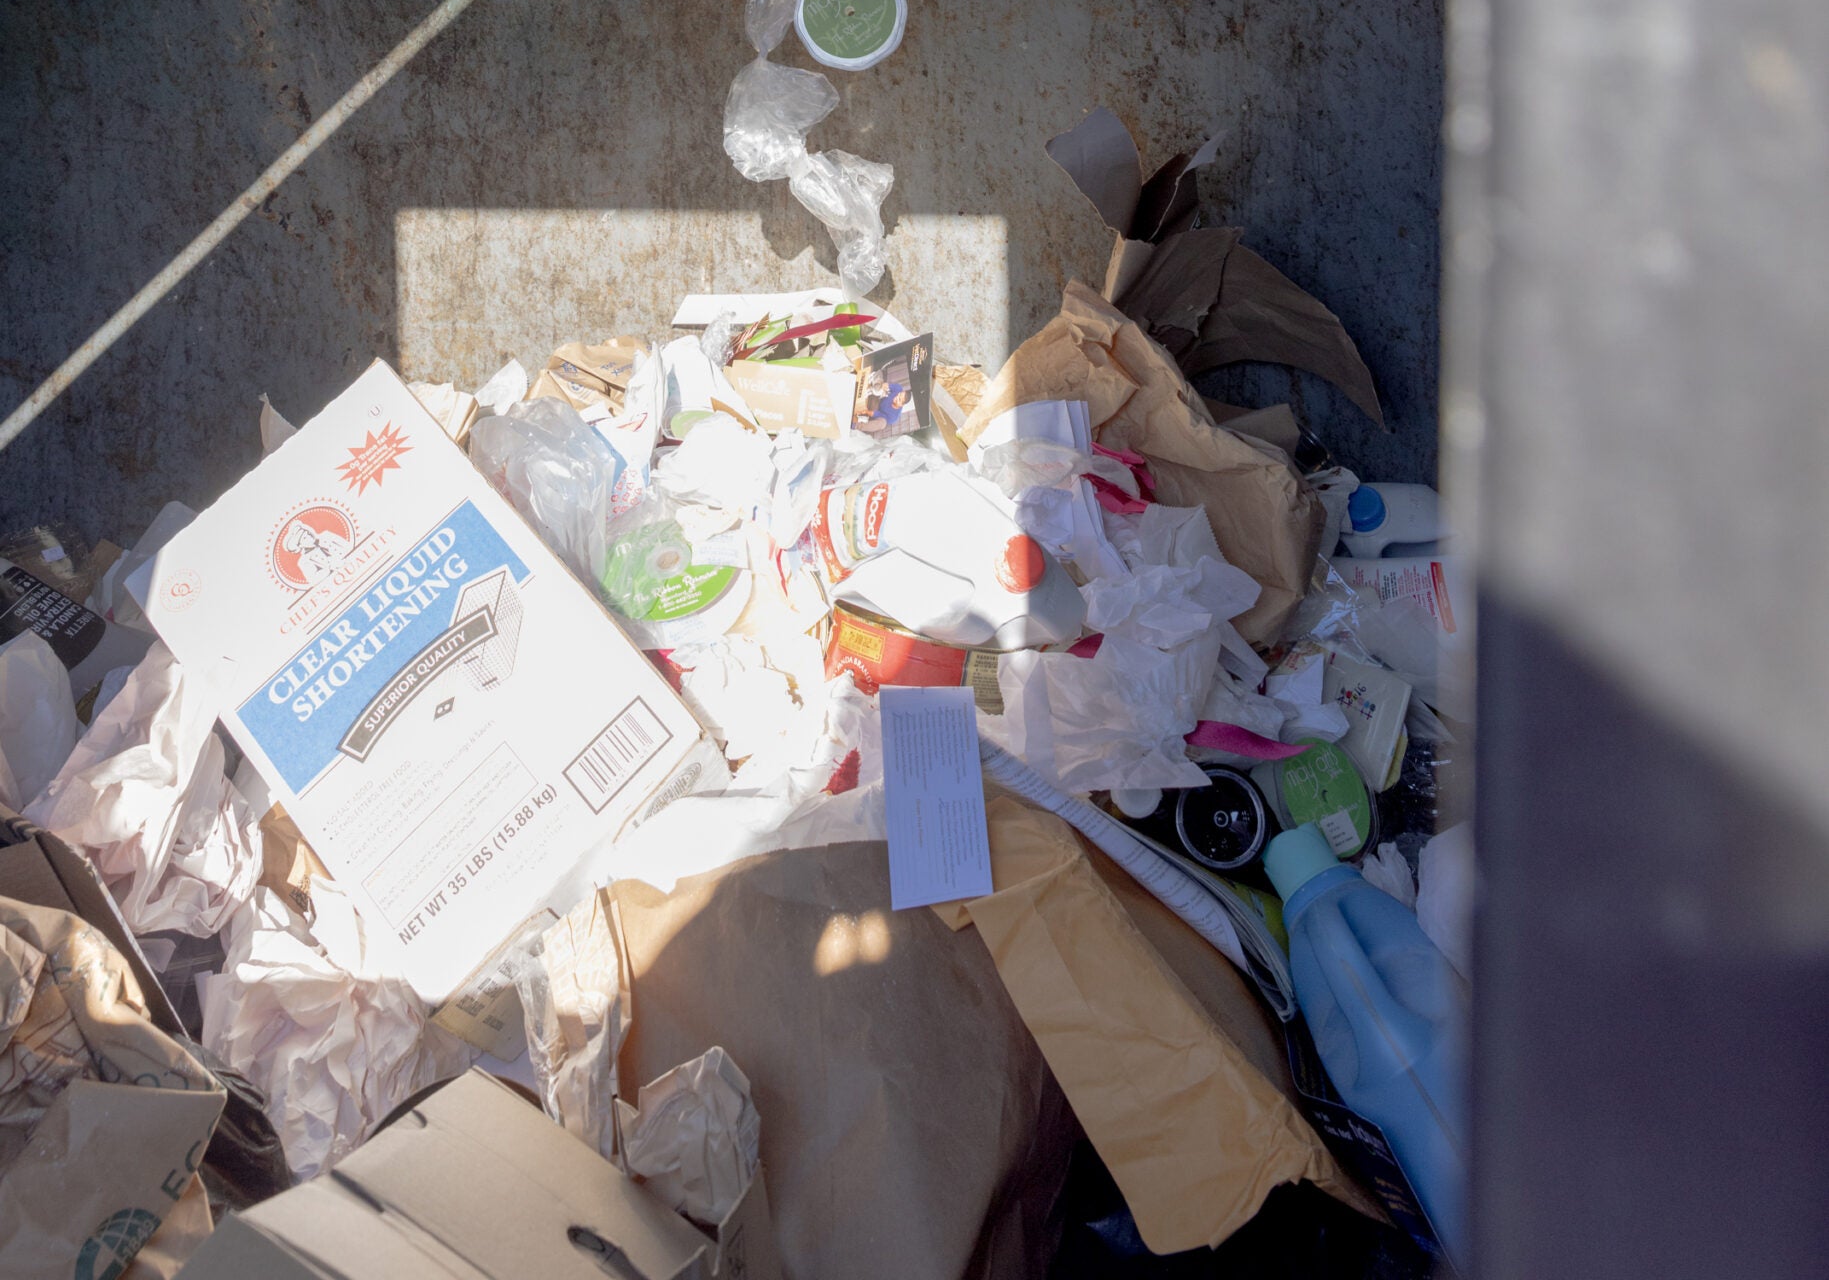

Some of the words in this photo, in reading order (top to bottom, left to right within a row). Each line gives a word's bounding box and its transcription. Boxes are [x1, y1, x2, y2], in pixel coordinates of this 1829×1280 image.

[867, 489, 886, 540] Hood
[37, 591, 62, 611] OLIVE
[279, 587, 331, 635] CHEF'S
[333, 524, 397, 586] QUALITY
[13, 597, 38, 616] BLEND
[22, 609, 40, 622] OIL
[44, 597, 73, 619] EXTRA
[268, 619, 360, 705] CLEAR
[358, 527, 456, 622] LIQUID
[41, 629, 53, 638] &
[292, 553, 469, 722] SHORTENING
[364, 672, 418, 732] SUPERIOR
[417, 631, 467, 676] QUALITY
[398, 913, 426, 945] NET
[425, 890, 448, 917] WT
[447, 872, 467, 895] 35
[465, 846, 493, 876] LBS
[492, 806, 534, 851] (15.88
[532, 783, 558, 809] kg)
